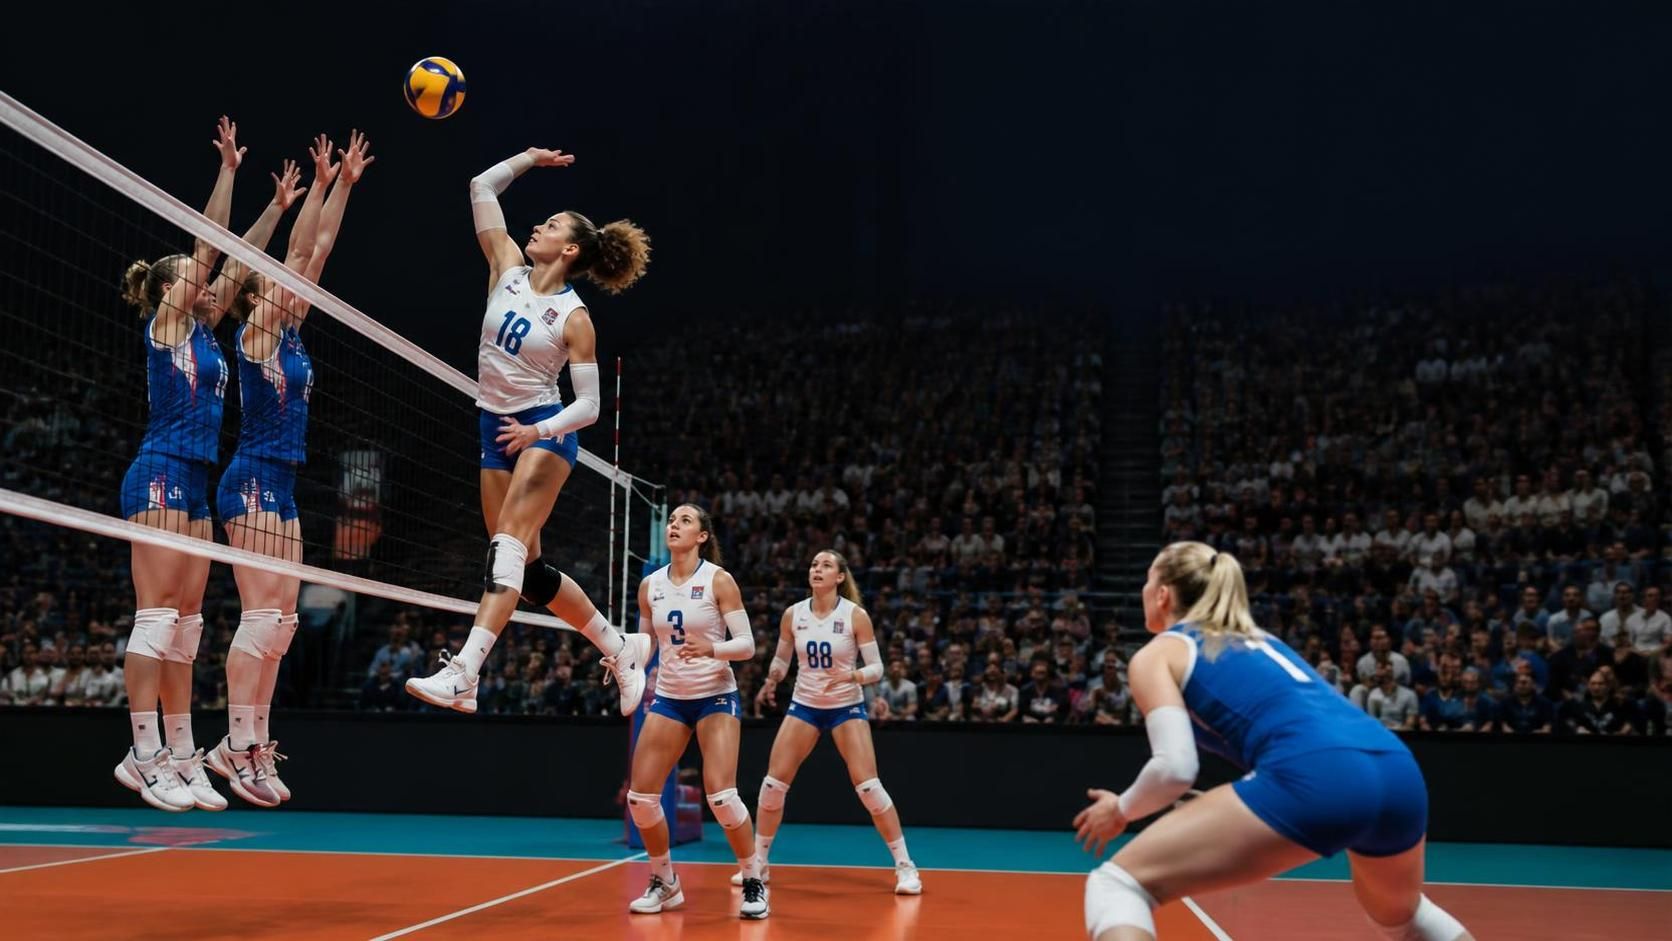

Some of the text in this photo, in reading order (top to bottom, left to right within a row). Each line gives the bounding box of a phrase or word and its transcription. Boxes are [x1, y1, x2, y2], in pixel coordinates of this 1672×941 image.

[496, 310, 532, 356] 18
[667, 610, 686, 645] 3
[806, 641, 833, 668] 88
